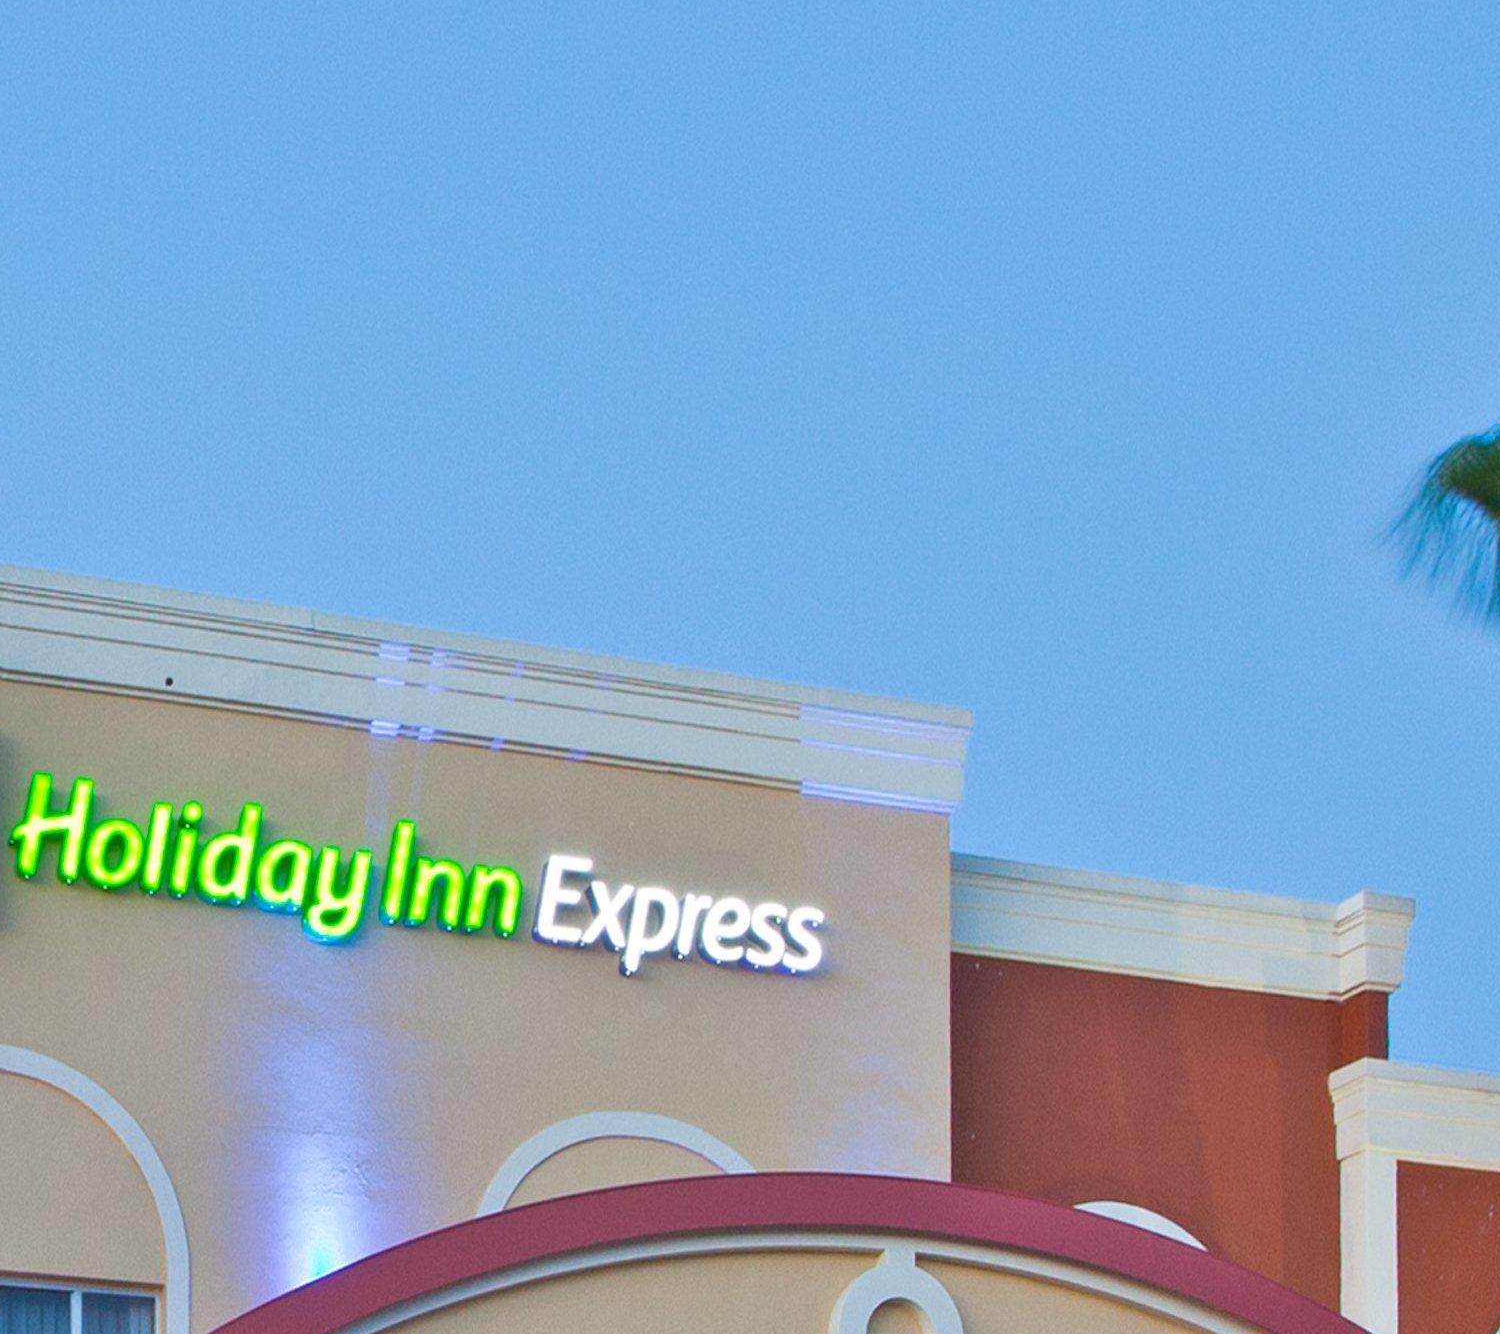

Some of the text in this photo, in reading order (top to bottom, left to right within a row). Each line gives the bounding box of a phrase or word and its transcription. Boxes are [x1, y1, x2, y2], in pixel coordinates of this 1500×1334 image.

[8, 772, 826, 977] Holiday Inn Express
